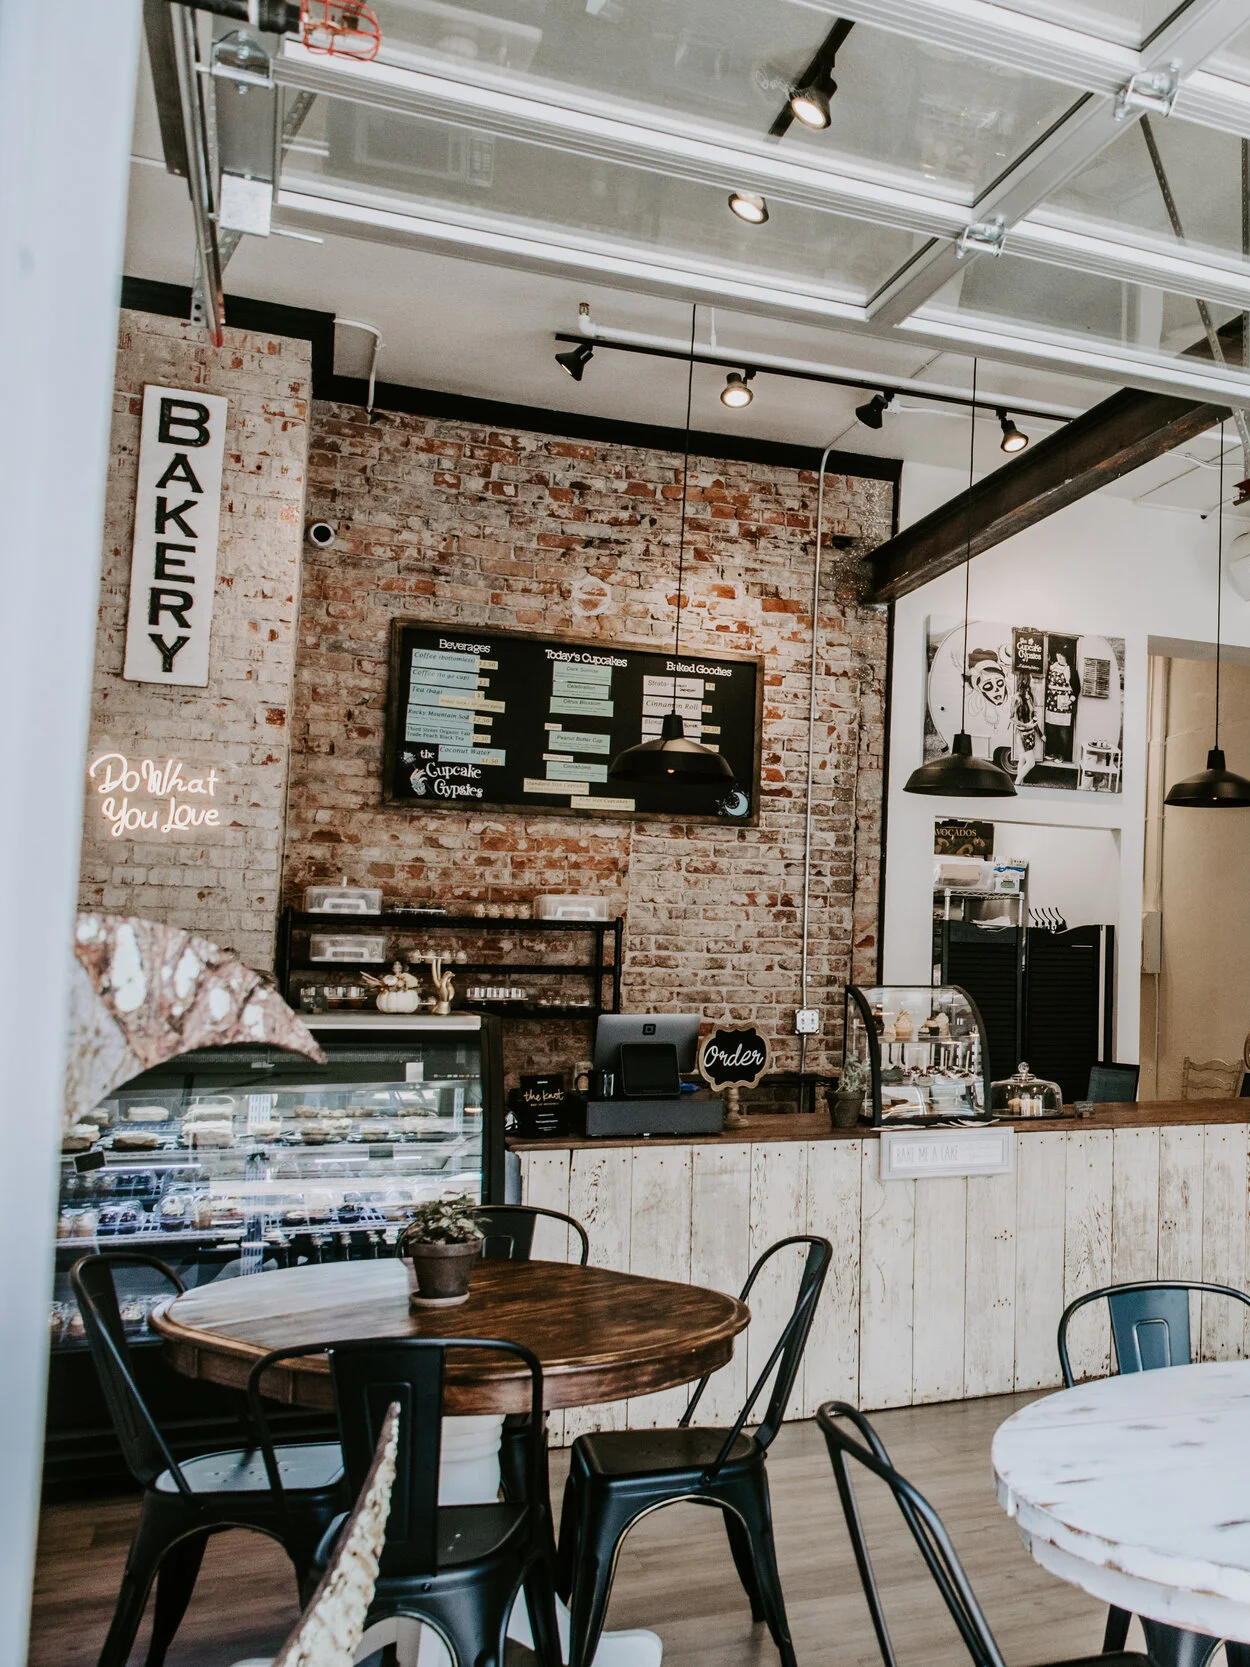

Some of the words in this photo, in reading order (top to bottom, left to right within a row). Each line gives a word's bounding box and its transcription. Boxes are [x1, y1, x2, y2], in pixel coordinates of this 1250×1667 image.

[148, 397, 210, 673] BAKERY
[439, 639, 491, 653] Beverages
[414, 650, 436, 660] Coffee
[545, 649, 581, 663] Today's
[581, 653, 628, 667] Cupcakes
[412, 668, 436, 677] Coffee
[666, 660, 696, 673] Baked
[696, 664, 732, 677] Goodies
[412, 685, 424, 693] Tea
[426, 687, 443, 695] (bag)
[408, 708, 426, 716] Rocky
[427, 709, 457, 719] Mountain
[684, 702, 699, 710] Roll
[420, 749, 435, 759] the
[440, 746, 469, 755] Coconut
[470, 748, 491, 756] Water
[89, 752, 141, 794] Do
[141, 759, 220, 796] What
[425, 761, 482, 779] Cupcake
[434, 778, 484, 798] Gypsies
[101, 797, 158, 837] You
[160, 796, 221, 834] Love
[704, 1043, 764, 1067] Order
[523, 1089, 541, 1102] the
[542, 1088, 564, 1101] knot
[896, 1146, 914, 1164] BAKE
[918, 1146, 928, 1162] ME
[932, 1145, 938, 1161] A
[941, 1144, 959, 1161] CAKE
